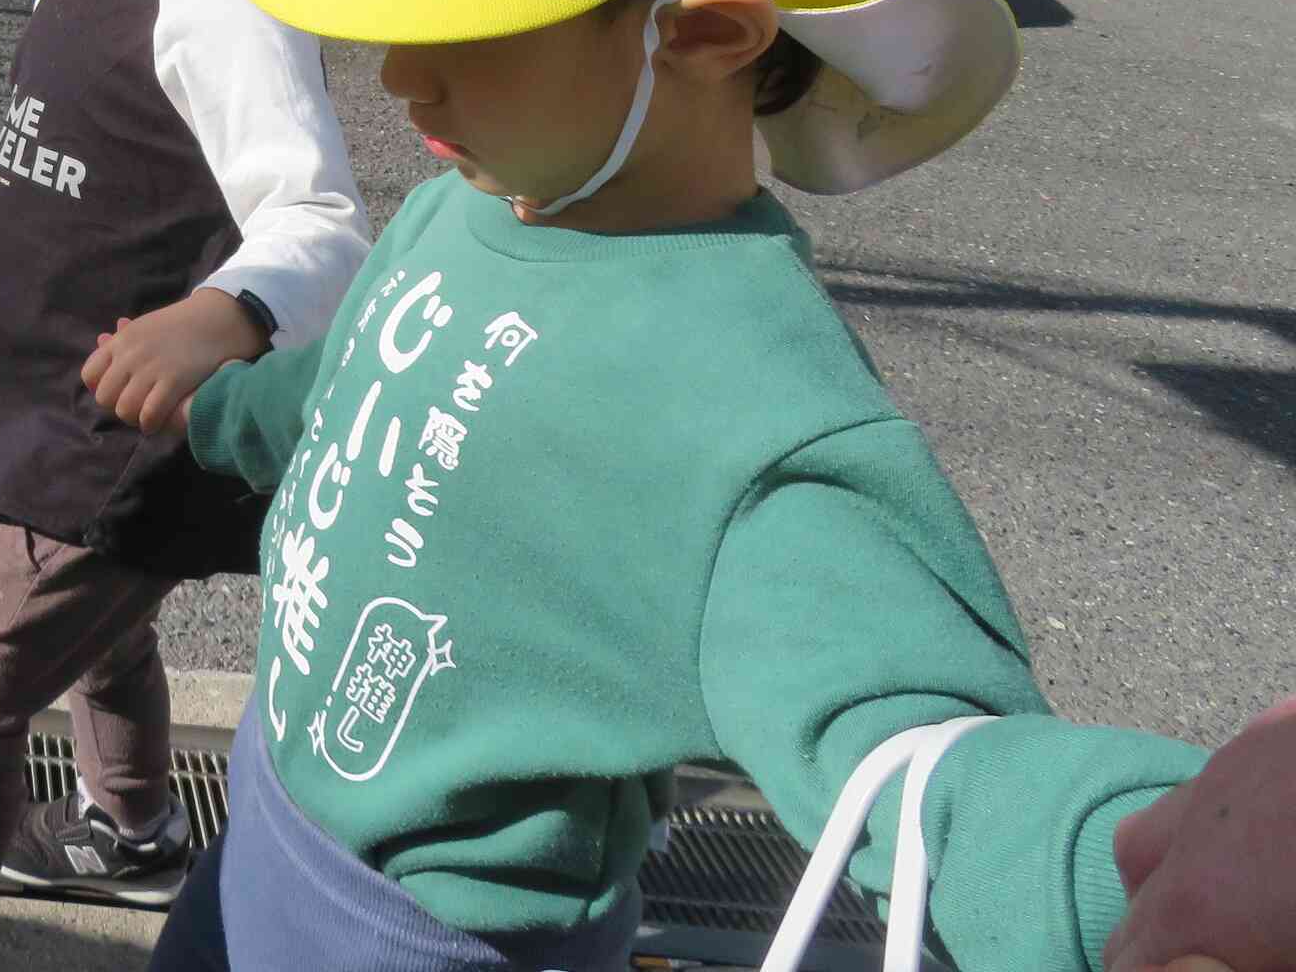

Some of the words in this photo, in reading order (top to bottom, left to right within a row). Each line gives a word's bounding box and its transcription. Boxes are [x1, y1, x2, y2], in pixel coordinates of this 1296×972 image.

[384, 311, 540, 568] 何を隠そう
[337, 623, 417, 753] 神推し
